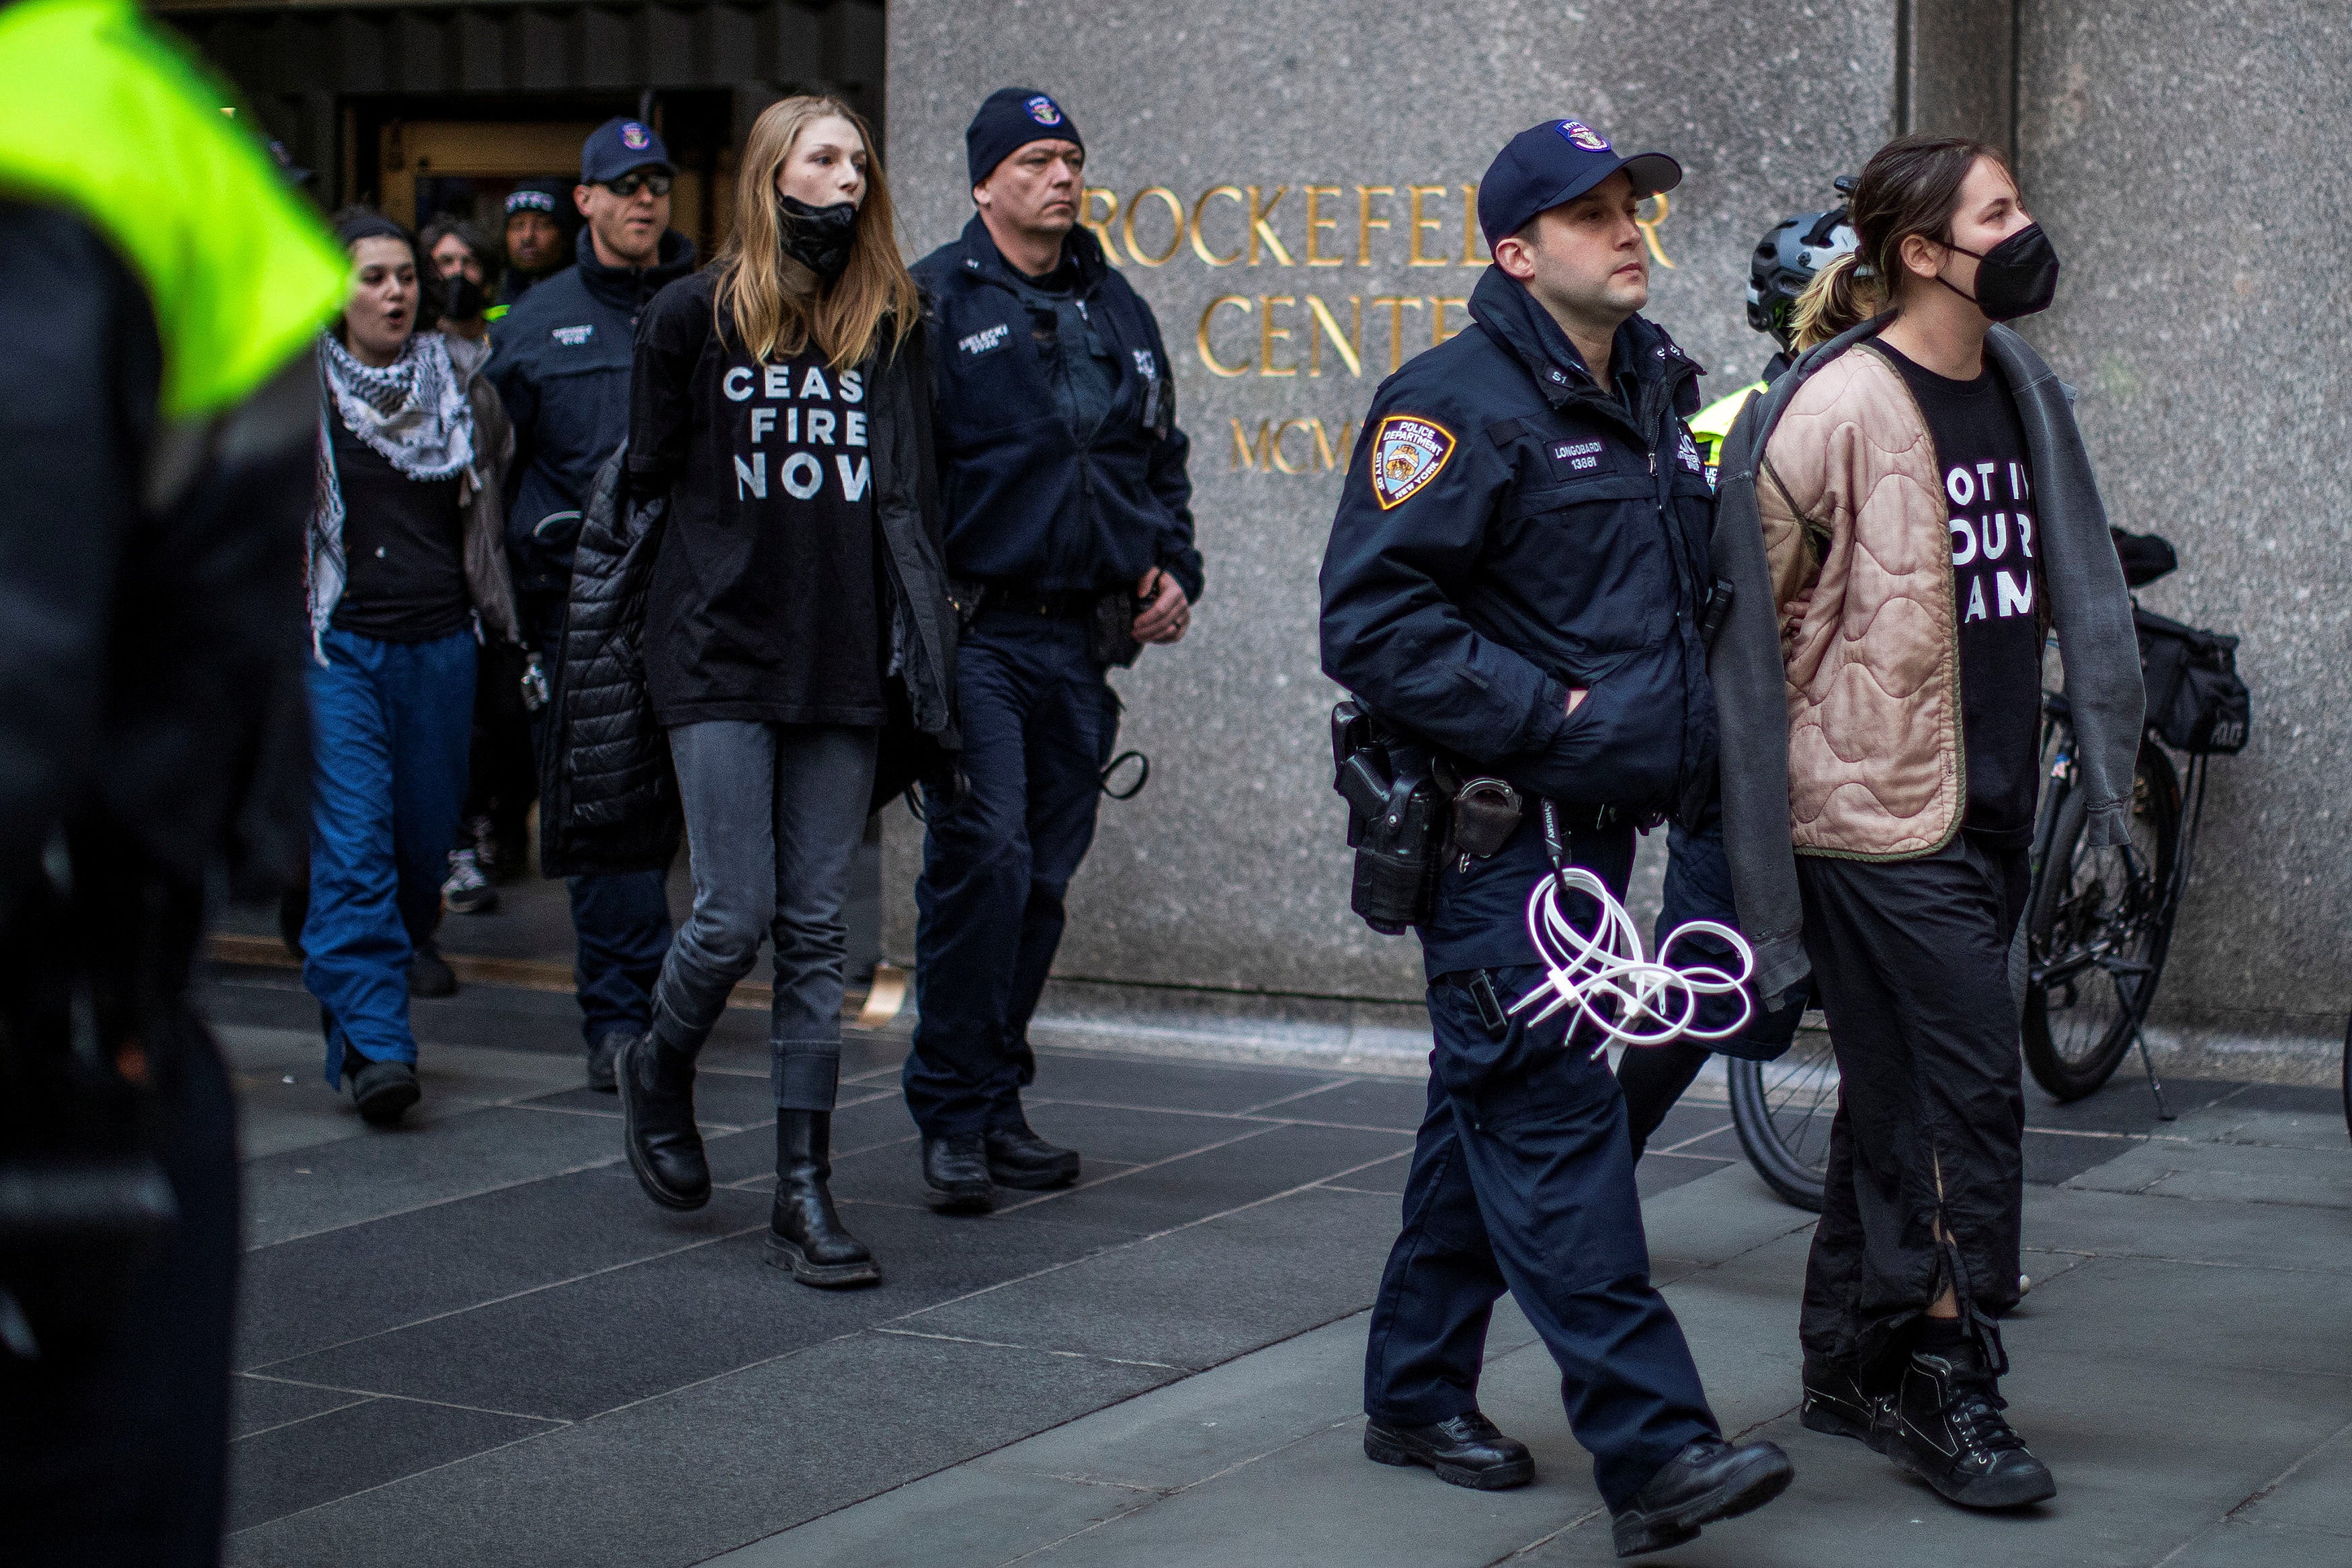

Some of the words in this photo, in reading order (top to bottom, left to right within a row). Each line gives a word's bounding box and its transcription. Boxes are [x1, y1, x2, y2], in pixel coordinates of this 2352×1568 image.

[1081, 185, 1677, 267] ROCKEFELR
[1198, 294, 1468, 378] CENTE
[723, 364, 864, 404] CEAS
[1552, 371, 1567, 384] S1
[751, 406, 869, 448] FIRE
[1230, 417, 1365, 475] MCM
[1382, 431, 1443, 456] DEPARTMENT
[1399, 422, 1435, 439] POLICE
[1375, 451, 1383, 476] CITY
[1554, 441, 1603, 460] LONGOBARDI
[1376, 476, 1386, 491] OF
[1394, 482, 1415, 500] NEW
[1414, 461, 1439, 484] YORK
[1946, 462, 1995, 506] OT
[1948, 513, 2033, 566] OUR
[1964, 570, 2034, 623] AM
[1545, 812, 1555, 838] HUSKY
